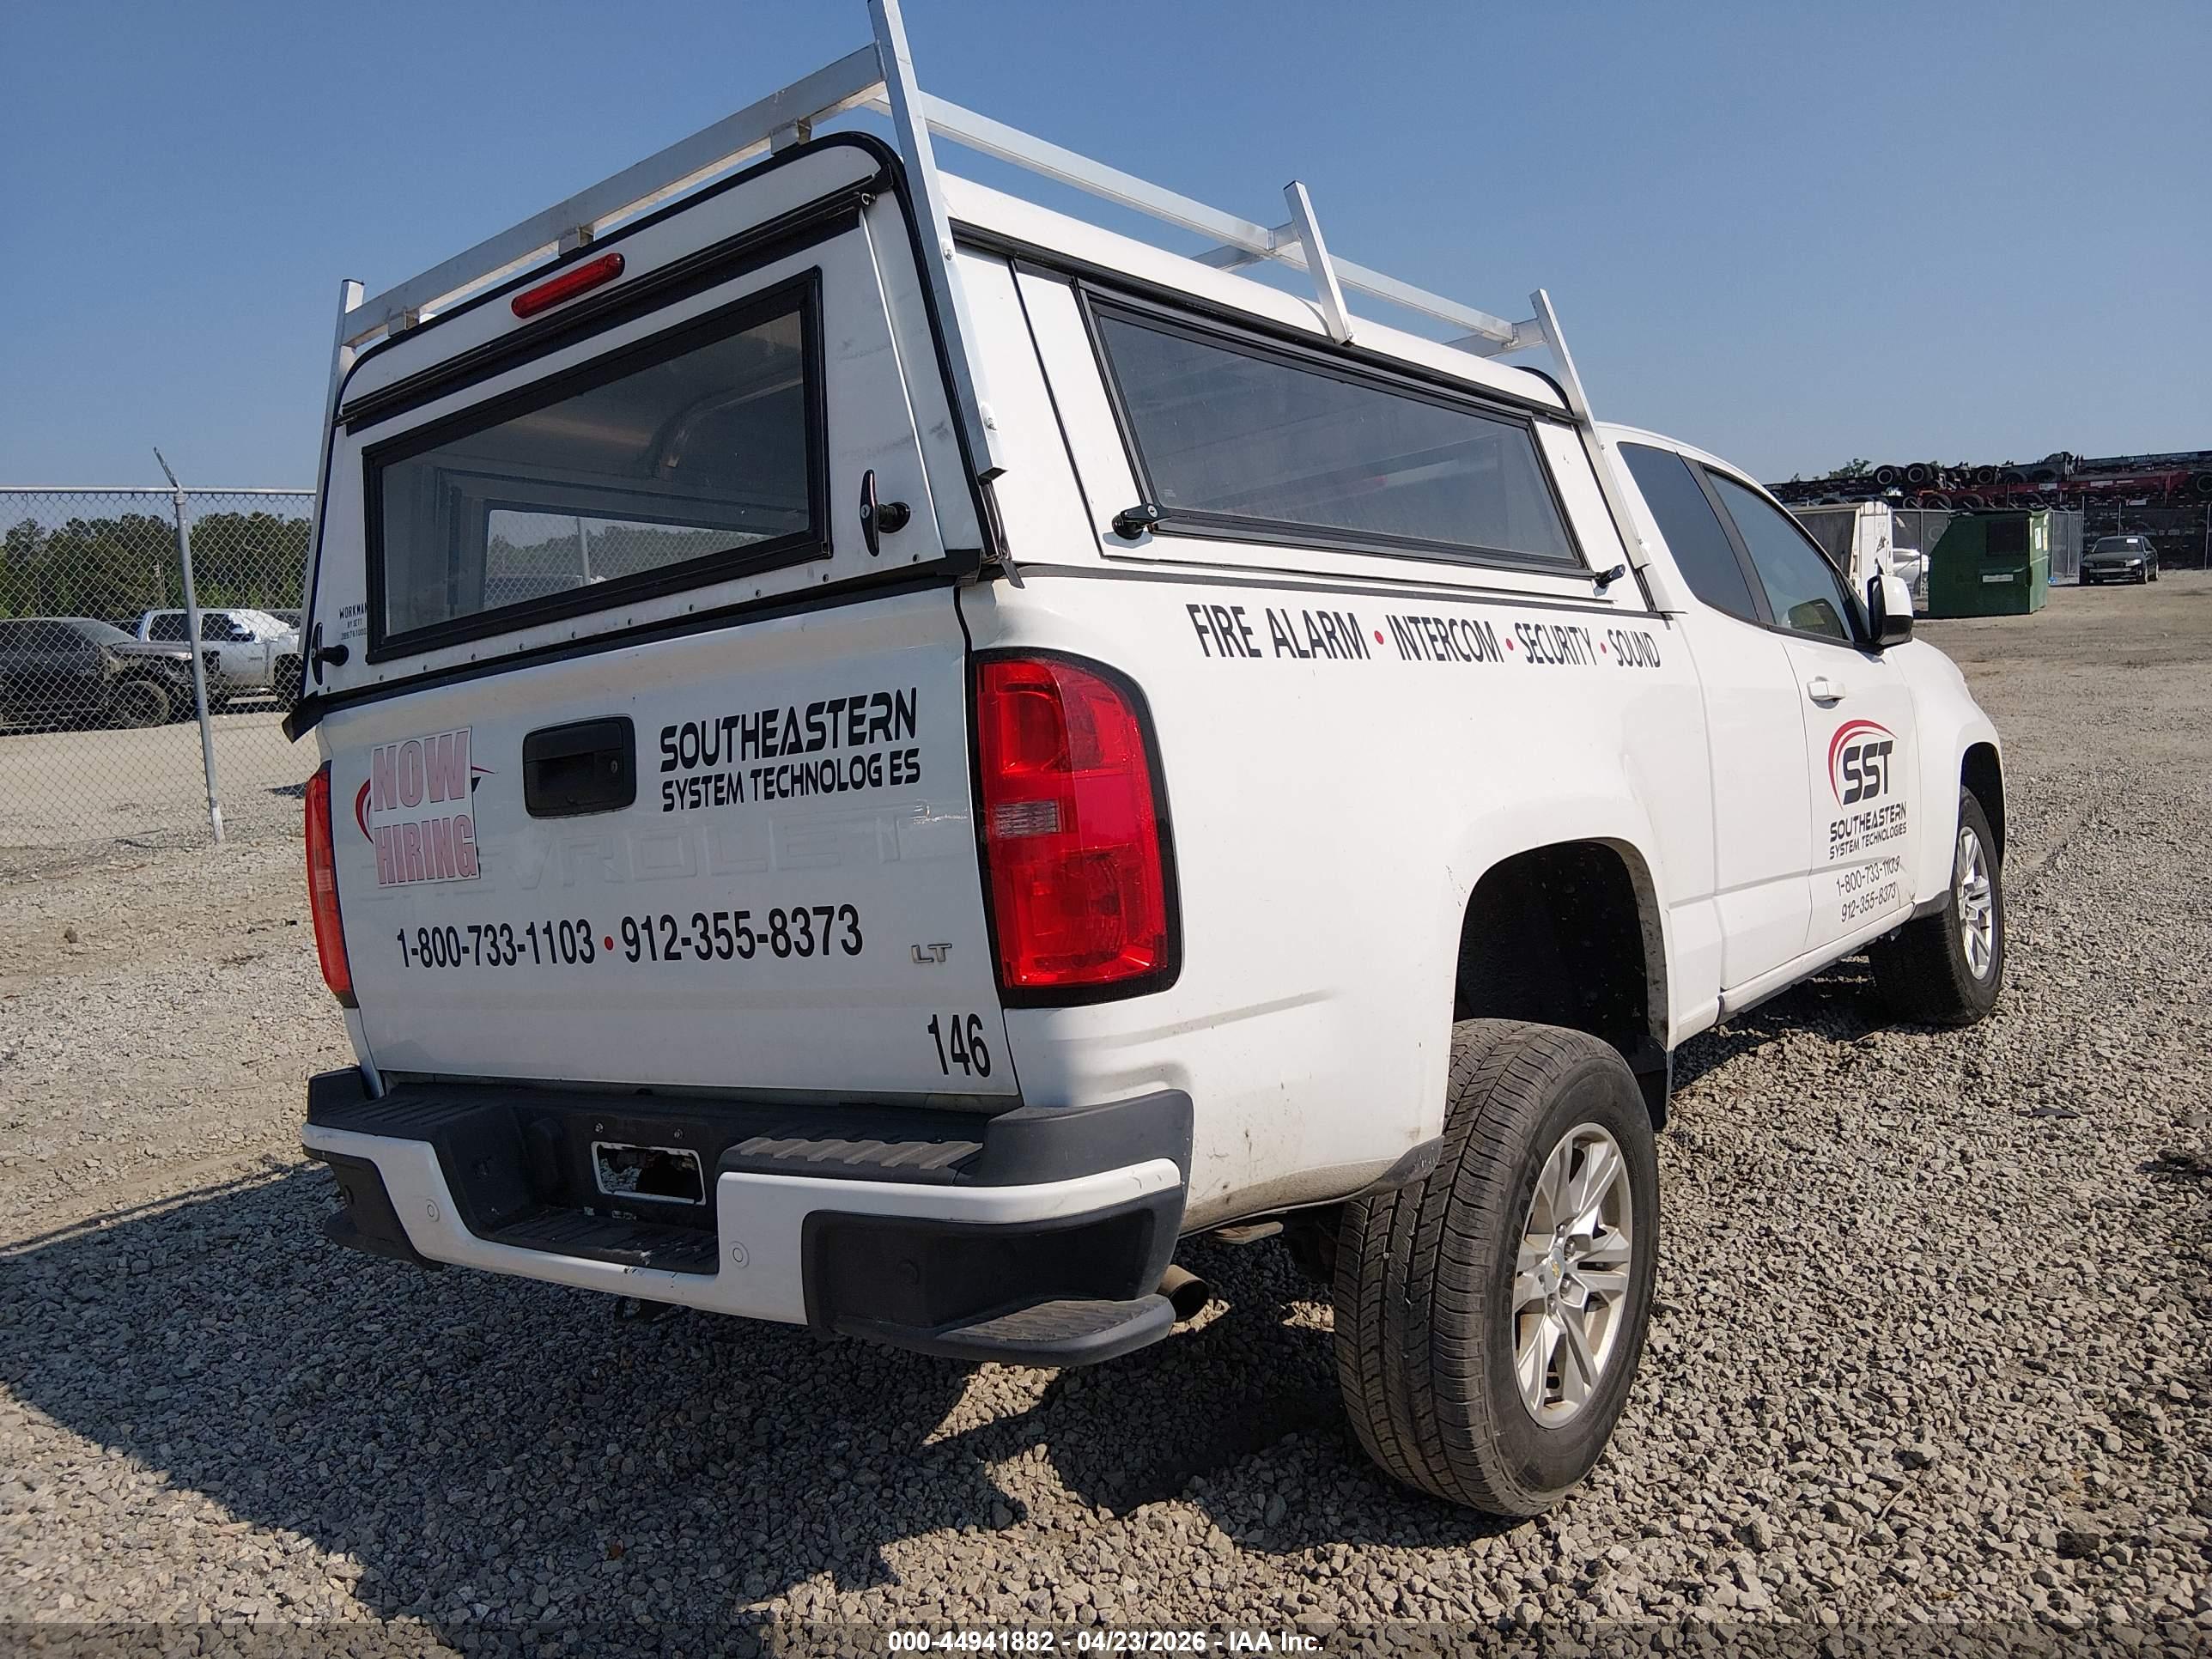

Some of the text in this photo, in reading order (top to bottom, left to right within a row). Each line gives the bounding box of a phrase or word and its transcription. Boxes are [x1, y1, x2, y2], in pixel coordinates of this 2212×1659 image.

[1186, 604, 1371, 660] FIRE ALARM
[1385, 615, 1504, 663] INTERCOM
[1515, 623, 1598, 665] SECURITY
[1609, 629, 1661, 668] SOUND
[659, 687, 917, 773] SOUTHEASTERN
[373, 730, 469, 812] NOW
[662, 771, 744, 812] SYSTEM
[1843, 739, 1893, 805] SST
[1829, 801, 1907, 843] SOUTHEASTERN
[1829, 822, 1907, 860] SYSTEM TECHNOLOGIES
[374, 814, 477, 885] HIRING
[1836, 855, 1900, 896] 1-800-733-1103
[1841, 881, 1896, 922] 912-355-8373
[396, 903, 864, 969] 1-800-733-1103 912-355-8373
[911, 943, 952, 963] LT
[927, 1013, 991, 1078] 146
